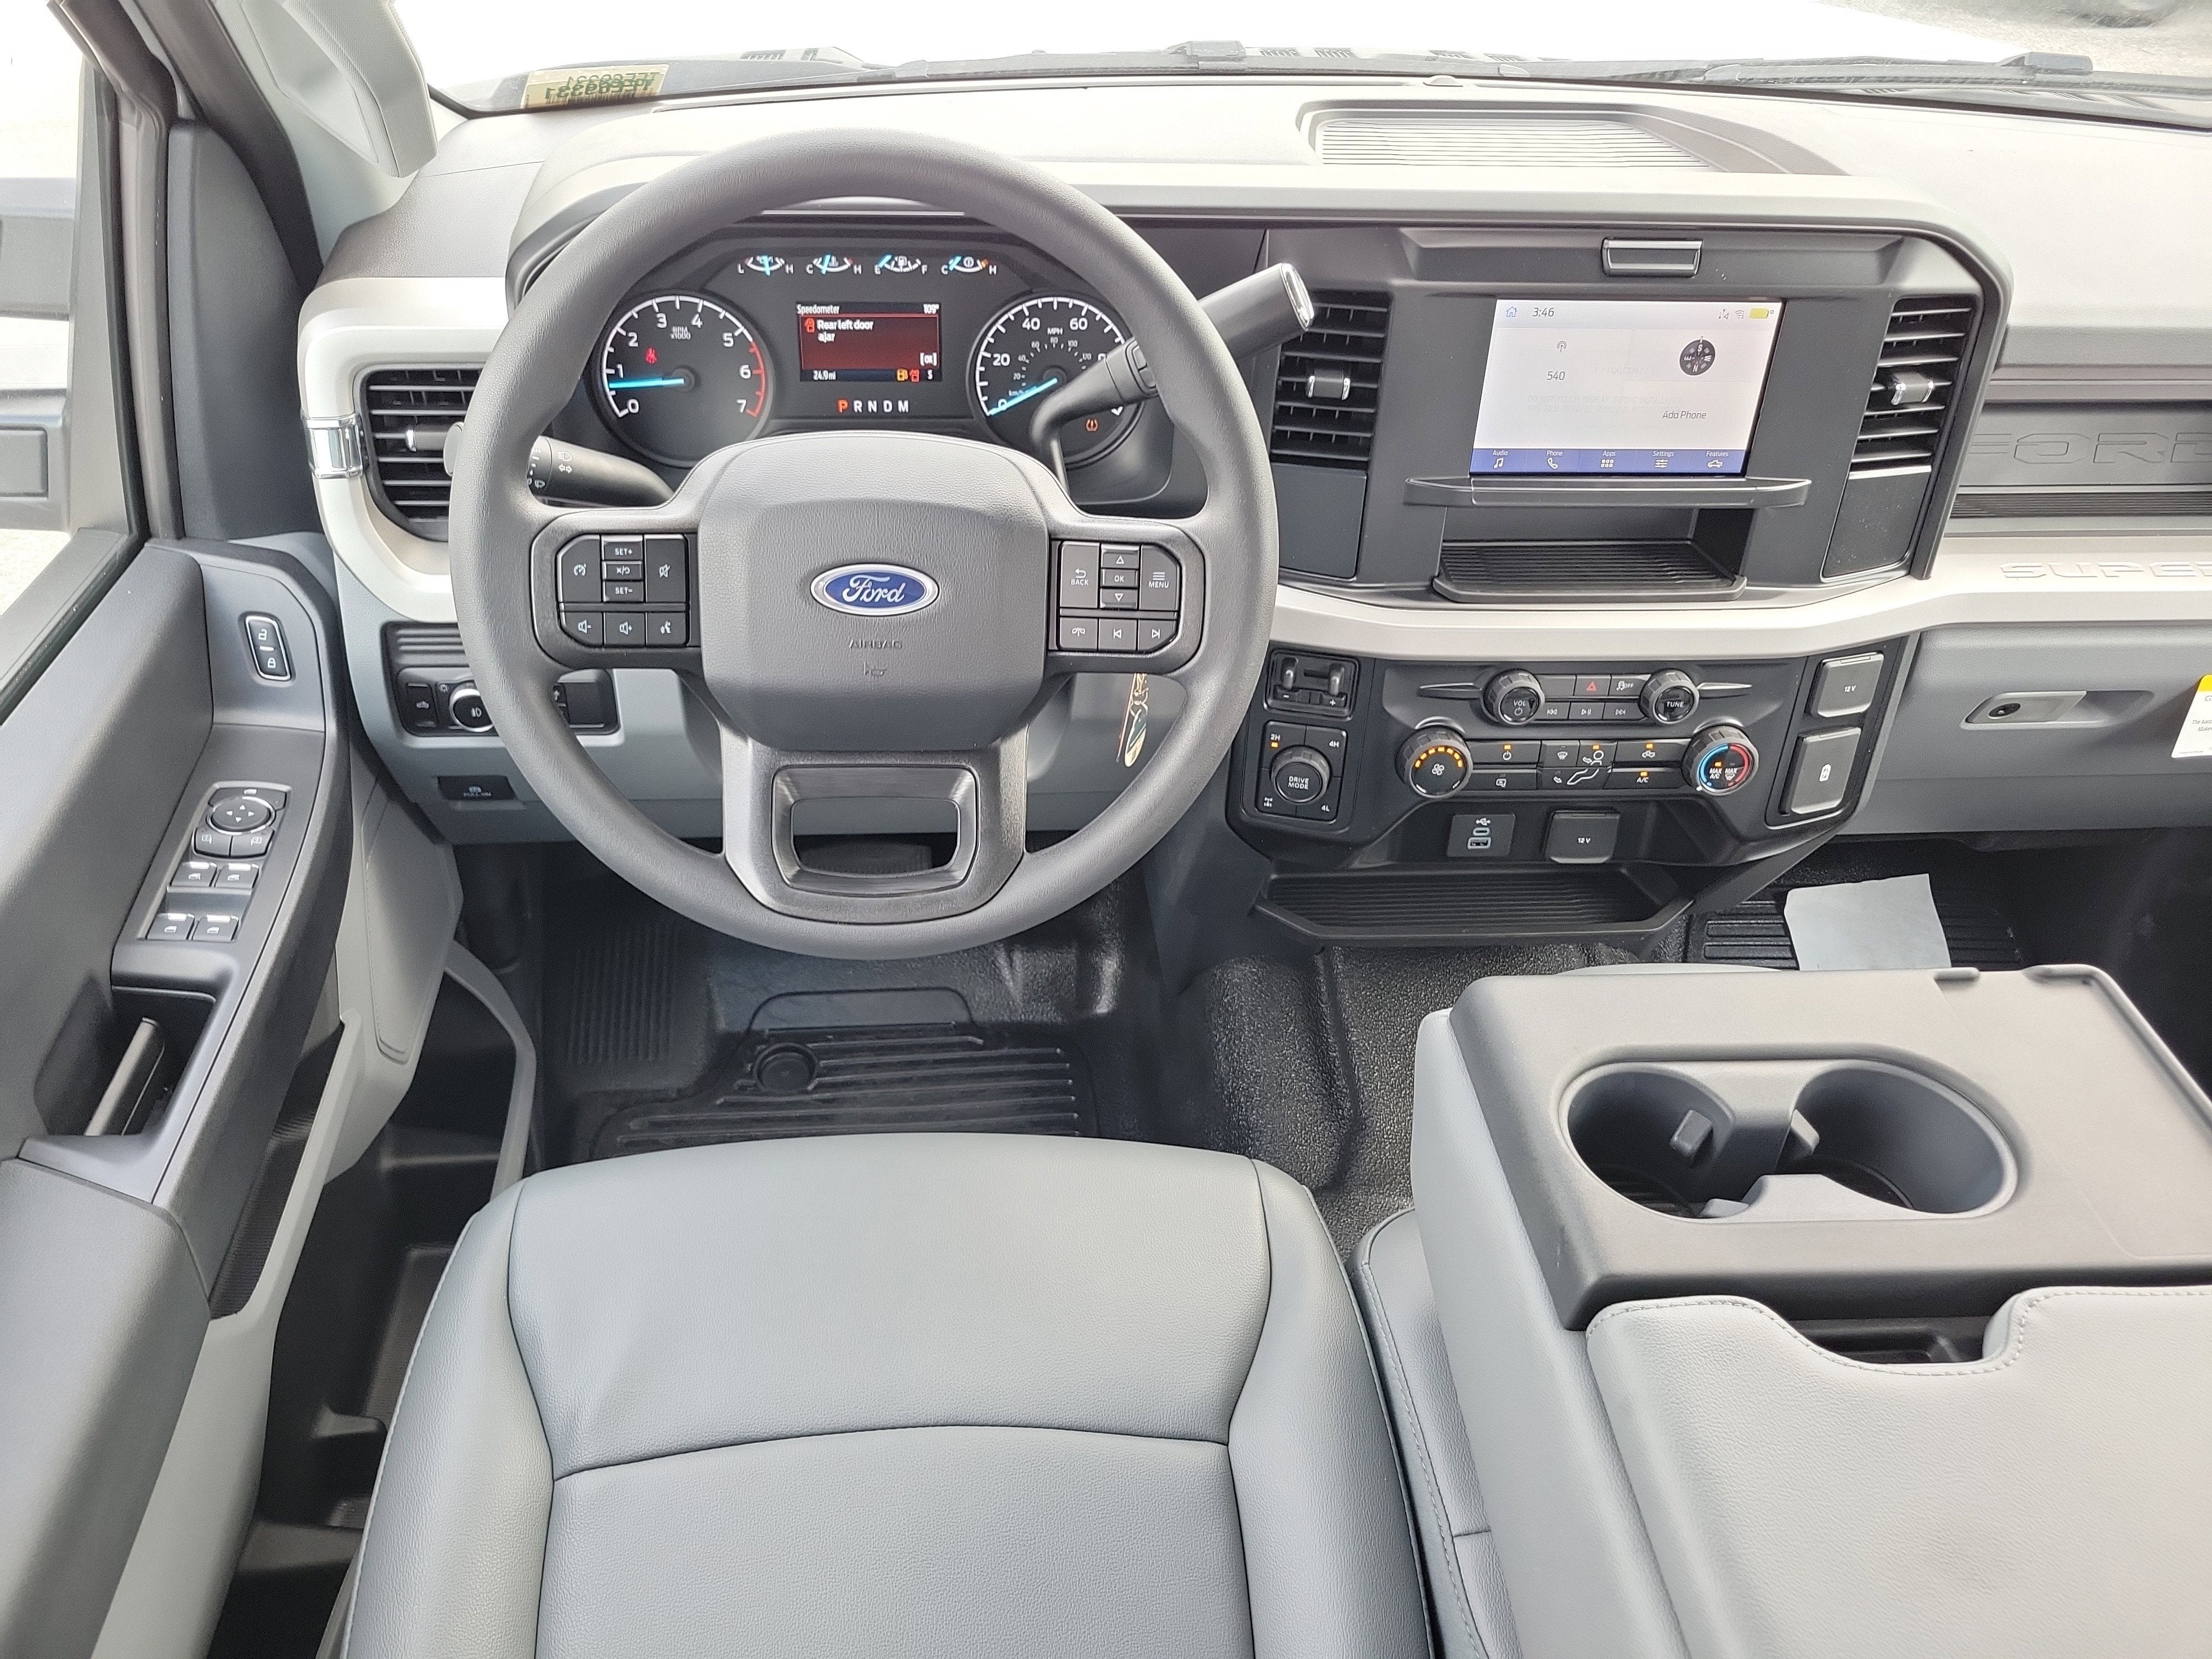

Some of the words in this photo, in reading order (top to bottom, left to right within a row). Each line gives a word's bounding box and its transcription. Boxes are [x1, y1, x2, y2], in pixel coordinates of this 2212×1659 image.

[737, 264, 744, 274] L
[785, 264, 794, 274] H
[806, 264, 813, 274] C
[854, 264, 862, 274] H
[921, 264, 928, 274] F
[941, 264, 948, 274] C
[989, 264, 997, 274] H
[797, 304, 840, 315] Speedometer
[1532, 307, 1555, 317] 3:46
[657, 313, 667, 328] 3
[691, 313, 703, 328] 4
[816, 319, 837, 330] Rear
[838, 319, 853, 330] left
[854, 319, 874, 330] door
[1022, 318, 1040, 330] 40
[1070, 318, 1088, 330] 60
[628, 332, 639, 347] 2
[723, 332, 734, 347] 5
[818, 332, 836, 343] ajar
[993, 353, 1011, 366] 20
[617, 364, 623, 378] 1
[740, 365, 751, 379] 6
[1547, 371, 1565, 381] 540
[628, 399, 639, 413] 0
[737, 399, 747, 413] 7
[838, 399, 848, 413] P
[853, 400, 862, 413] R
[867, 400, 877, 413] N
[883, 400, 893, 413] D
[898, 400, 909, 413] M
[1680, 410, 1706, 419] Phone
[1999, 561, 2212, 578] SUPE
[842, 574, 907, 603] Ford
[1289, 775, 1310, 784] DRIVE
[1321, 804, 1330, 812] 4L
